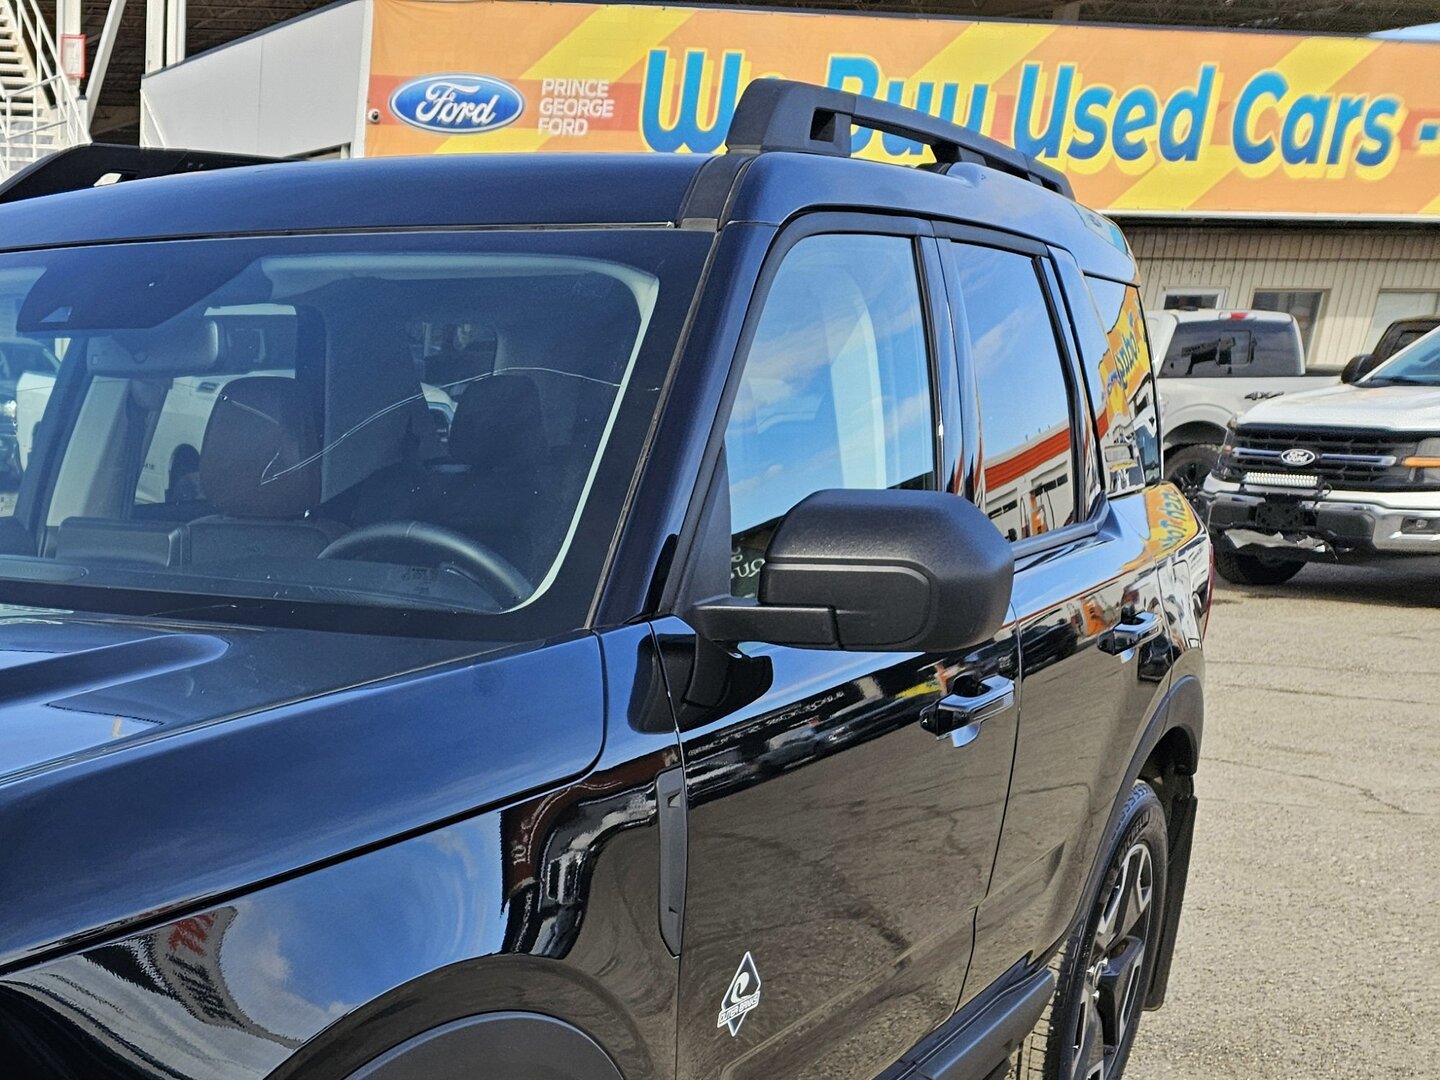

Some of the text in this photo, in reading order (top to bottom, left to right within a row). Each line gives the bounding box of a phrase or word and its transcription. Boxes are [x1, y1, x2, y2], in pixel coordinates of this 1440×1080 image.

[541, 79, 609, 97] PRINCE
[415, 82, 500, 126] Ford
[539, 99, 615, 116] GEORGE
[1012, 63, 1218, 163] Used
[1232, 70, 1402, 168] Cars
[537, 118, 589, 136] FORD
